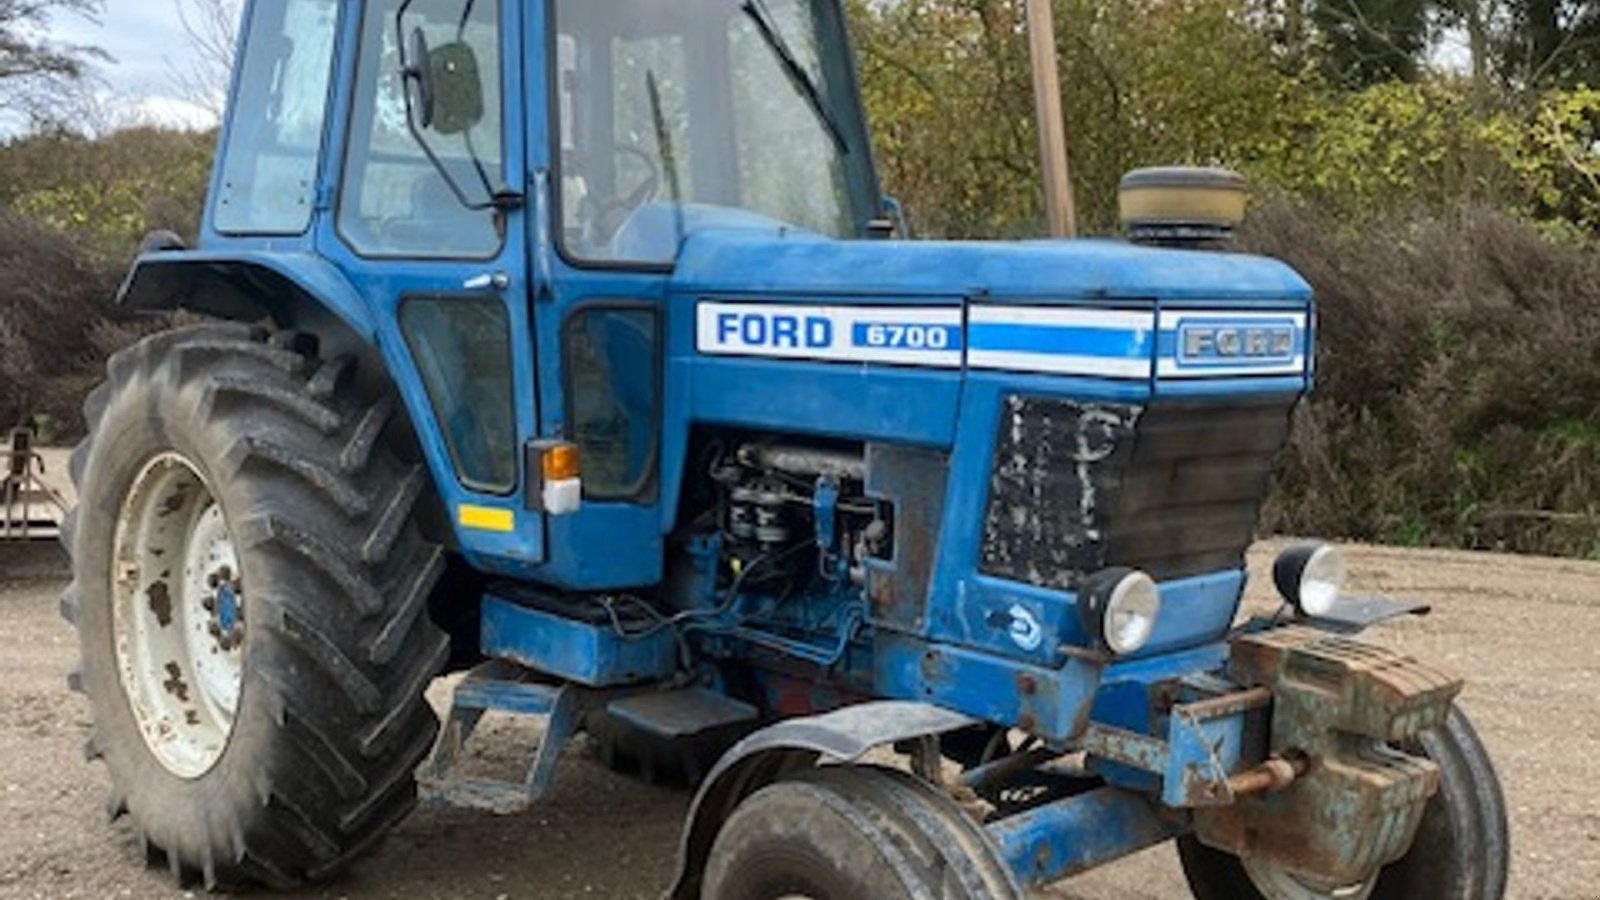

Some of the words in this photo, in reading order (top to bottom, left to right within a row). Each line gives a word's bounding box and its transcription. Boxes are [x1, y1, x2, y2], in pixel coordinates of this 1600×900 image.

[716, 313, 833, 348] FORD
[866, 325, 949, 349] 6700
[1184, 328, 1293, 357] FORD
